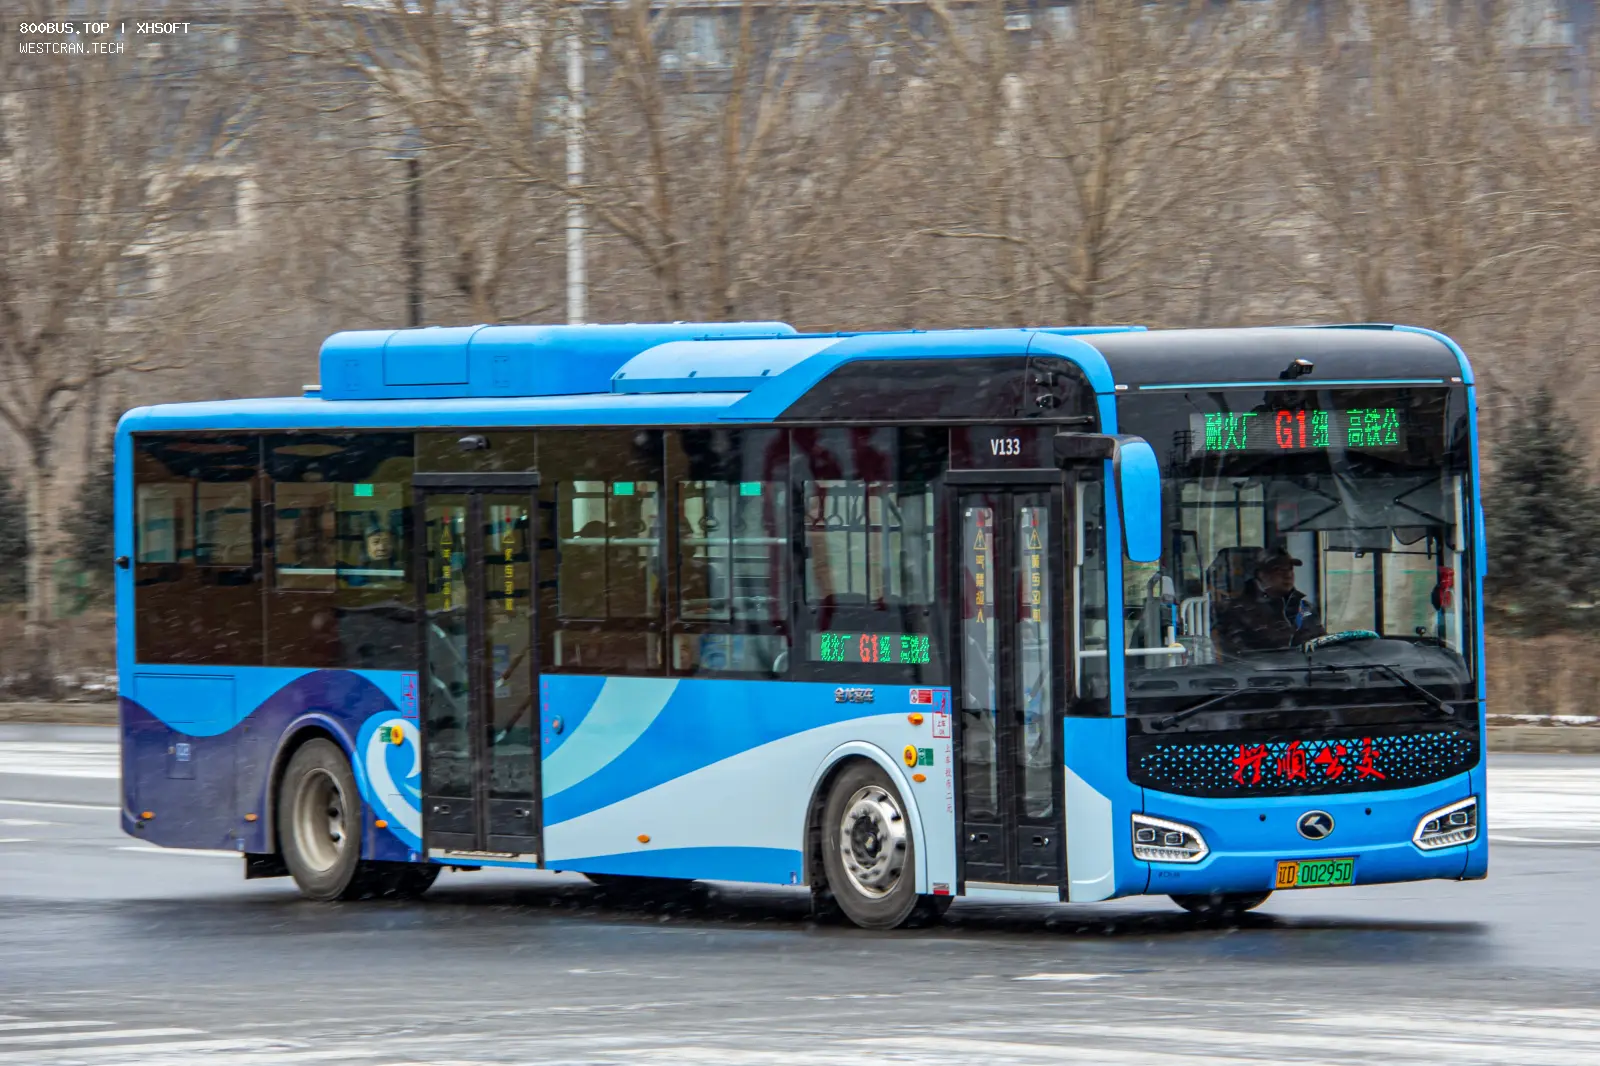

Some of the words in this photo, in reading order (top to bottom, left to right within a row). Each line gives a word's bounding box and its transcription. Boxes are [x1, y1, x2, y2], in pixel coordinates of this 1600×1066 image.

[1204, 411, 1258, 450] 耐火厂
[1275, 409, 1307, 449] G1
[990, 438, 1021, 456] V133
[1301, 862, 1352, 883] 00295D
